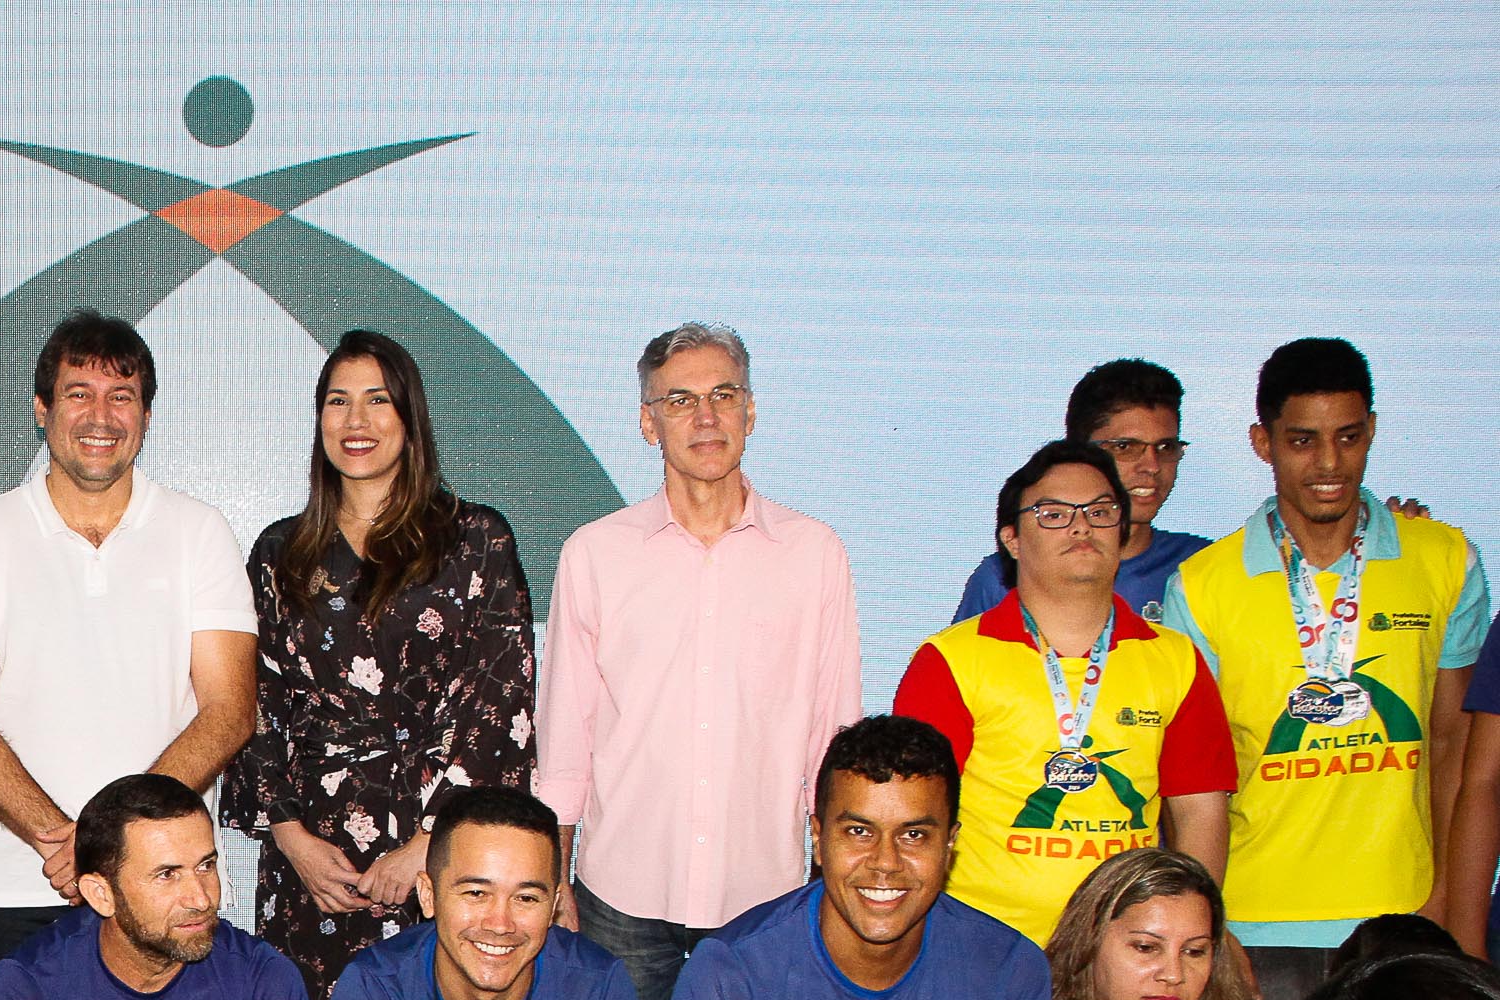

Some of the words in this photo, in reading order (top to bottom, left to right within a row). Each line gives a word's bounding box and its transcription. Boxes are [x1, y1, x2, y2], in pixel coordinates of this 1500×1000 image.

[1393, 619, 1430, 627] Fortaleza
[1306, 732, 1383, 751] ATLETA
[1260, 746, 1421, 782] CIDADÃO
[1060, 819, 1129, 832] ATLETA
